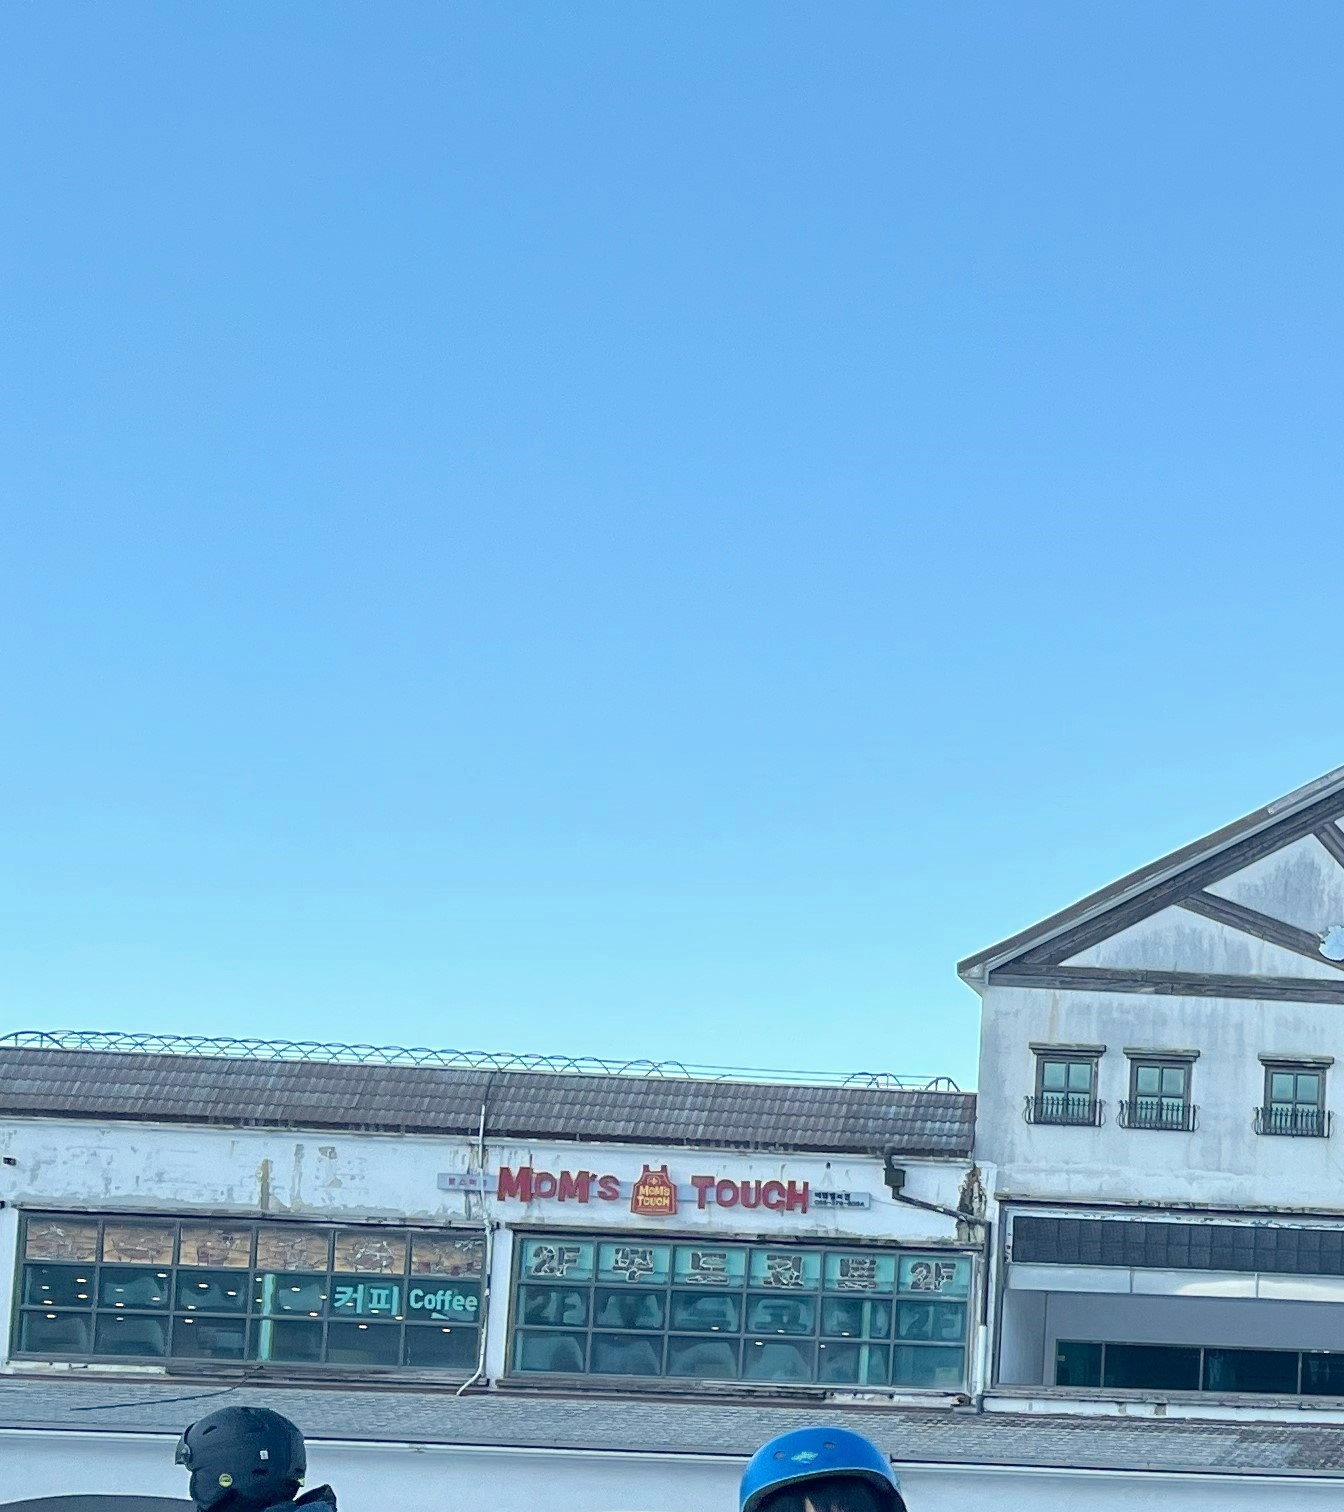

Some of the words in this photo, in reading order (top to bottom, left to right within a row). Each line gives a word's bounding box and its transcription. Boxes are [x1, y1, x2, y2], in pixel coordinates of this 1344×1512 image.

[637, 1195, 671, 1207] TOUCH
[691, 1175, 810, 1214] TOUCH
[910, 1260, 957, 1292] 2F
[333, 1283, 400, 1316] 커피
[408, 1288, 479, 1312] Coffee
